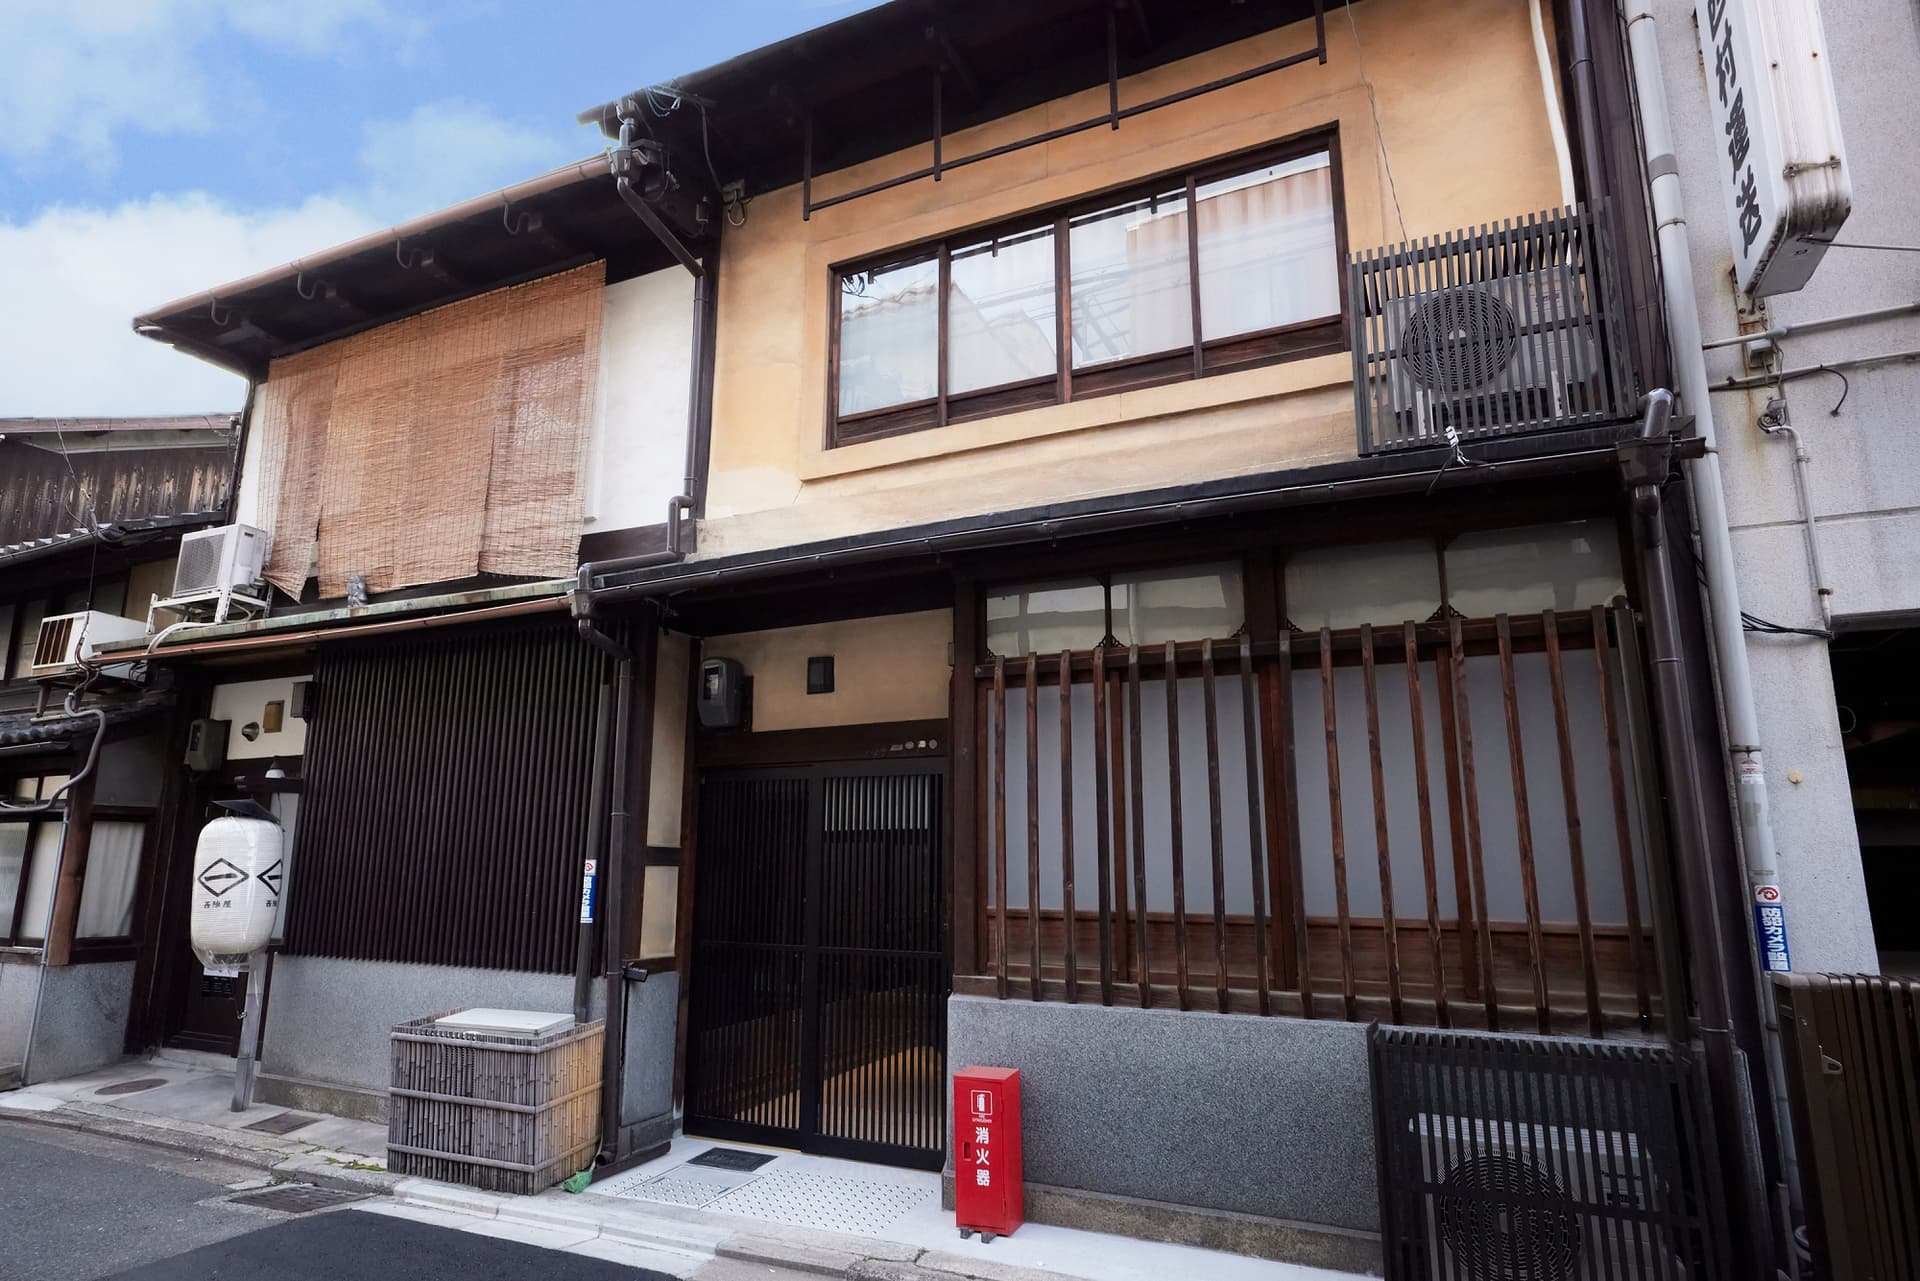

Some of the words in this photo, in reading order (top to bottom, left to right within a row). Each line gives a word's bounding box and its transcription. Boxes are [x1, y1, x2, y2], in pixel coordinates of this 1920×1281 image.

[1760, 907, 1790, 972] 防犯カメラ設置
[975, 1126, 991, 1187] 消火器
